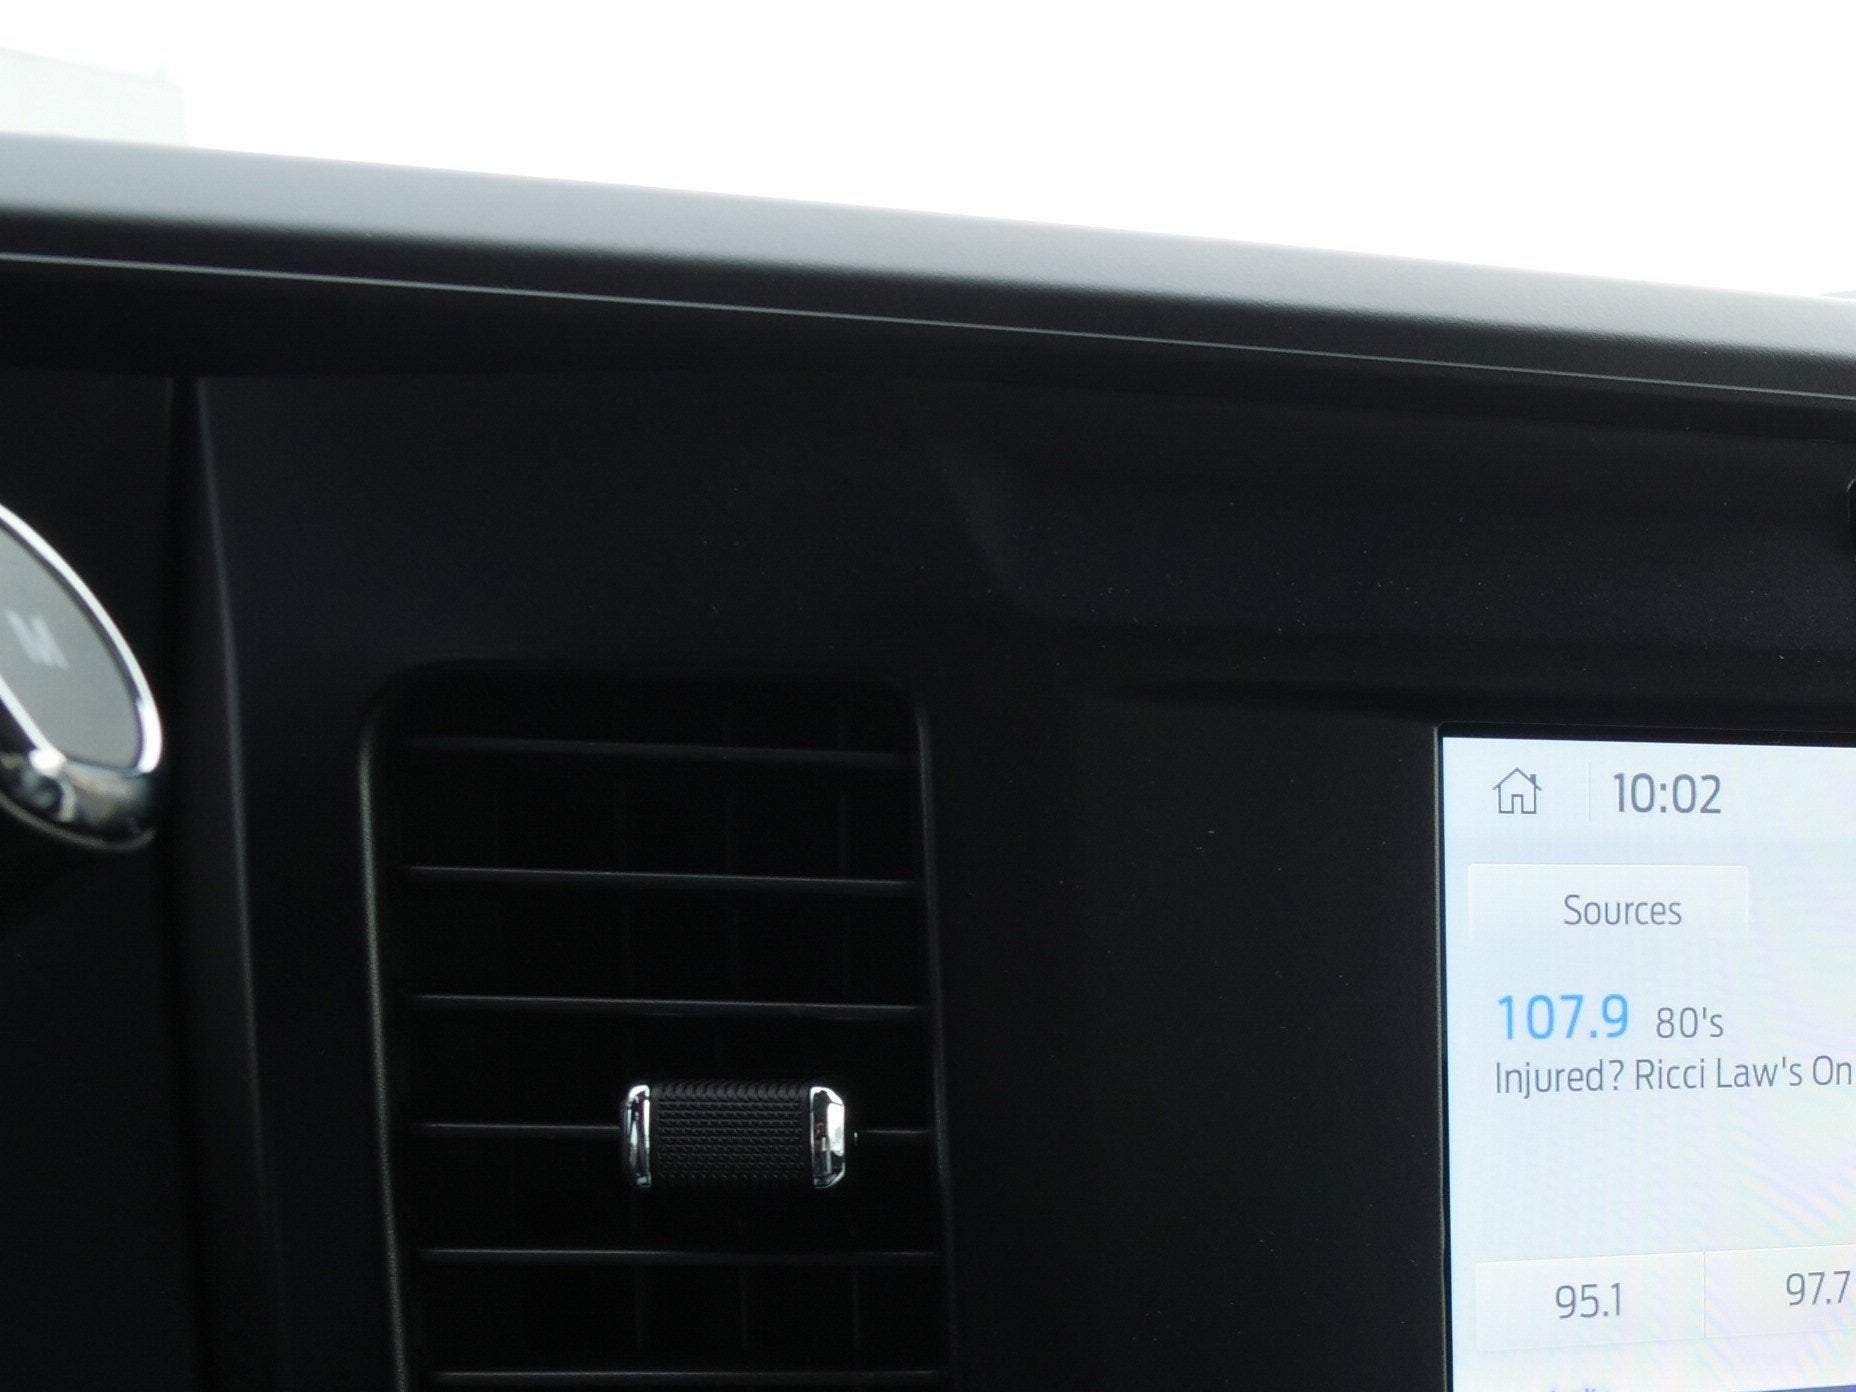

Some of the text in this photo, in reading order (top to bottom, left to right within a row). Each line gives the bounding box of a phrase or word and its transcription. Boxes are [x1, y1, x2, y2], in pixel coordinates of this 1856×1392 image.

[1614, 773, 1721, 813] 10:02
[1565, 895, 1681, 925] Sources
[1499, 994, 1723, 1039] 107.9 80's
[1497, 1059, 1624, 1099] Injured?
[1636, 1058, 1704, 1090] Ricci
[1718, 1057, 1802, 1088] Law's
[1813, 1056, 1851, 1085] On
[1556, 1283, 1620, 1319] 95.1
[1787, 1271, 1850, 1306] 97.7
